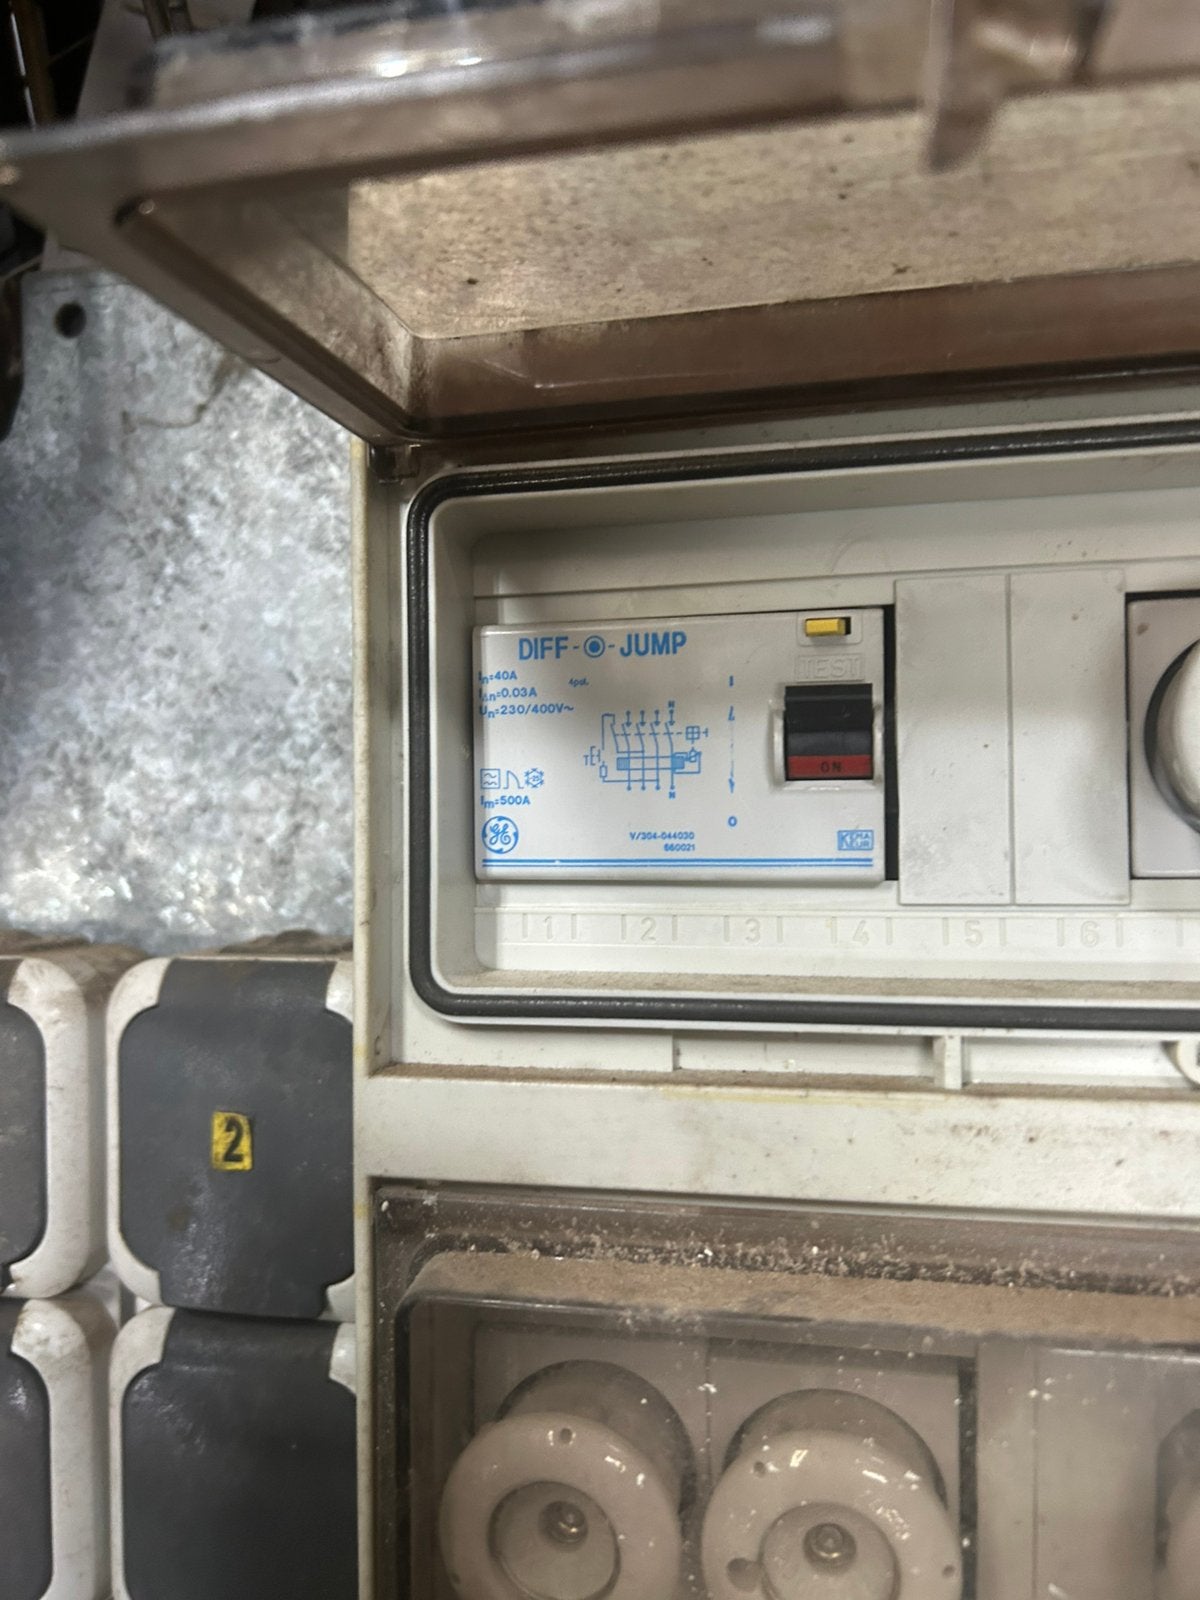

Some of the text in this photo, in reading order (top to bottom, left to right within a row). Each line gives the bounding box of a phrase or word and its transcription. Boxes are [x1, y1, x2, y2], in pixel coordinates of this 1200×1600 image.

[801, 657, 860, 679] TEST
[820, 760, 842, 774] ON
[544, 915, 1100, 947] 1 2 3 4 5 6
[223, 1117, 244, 1162] 2
